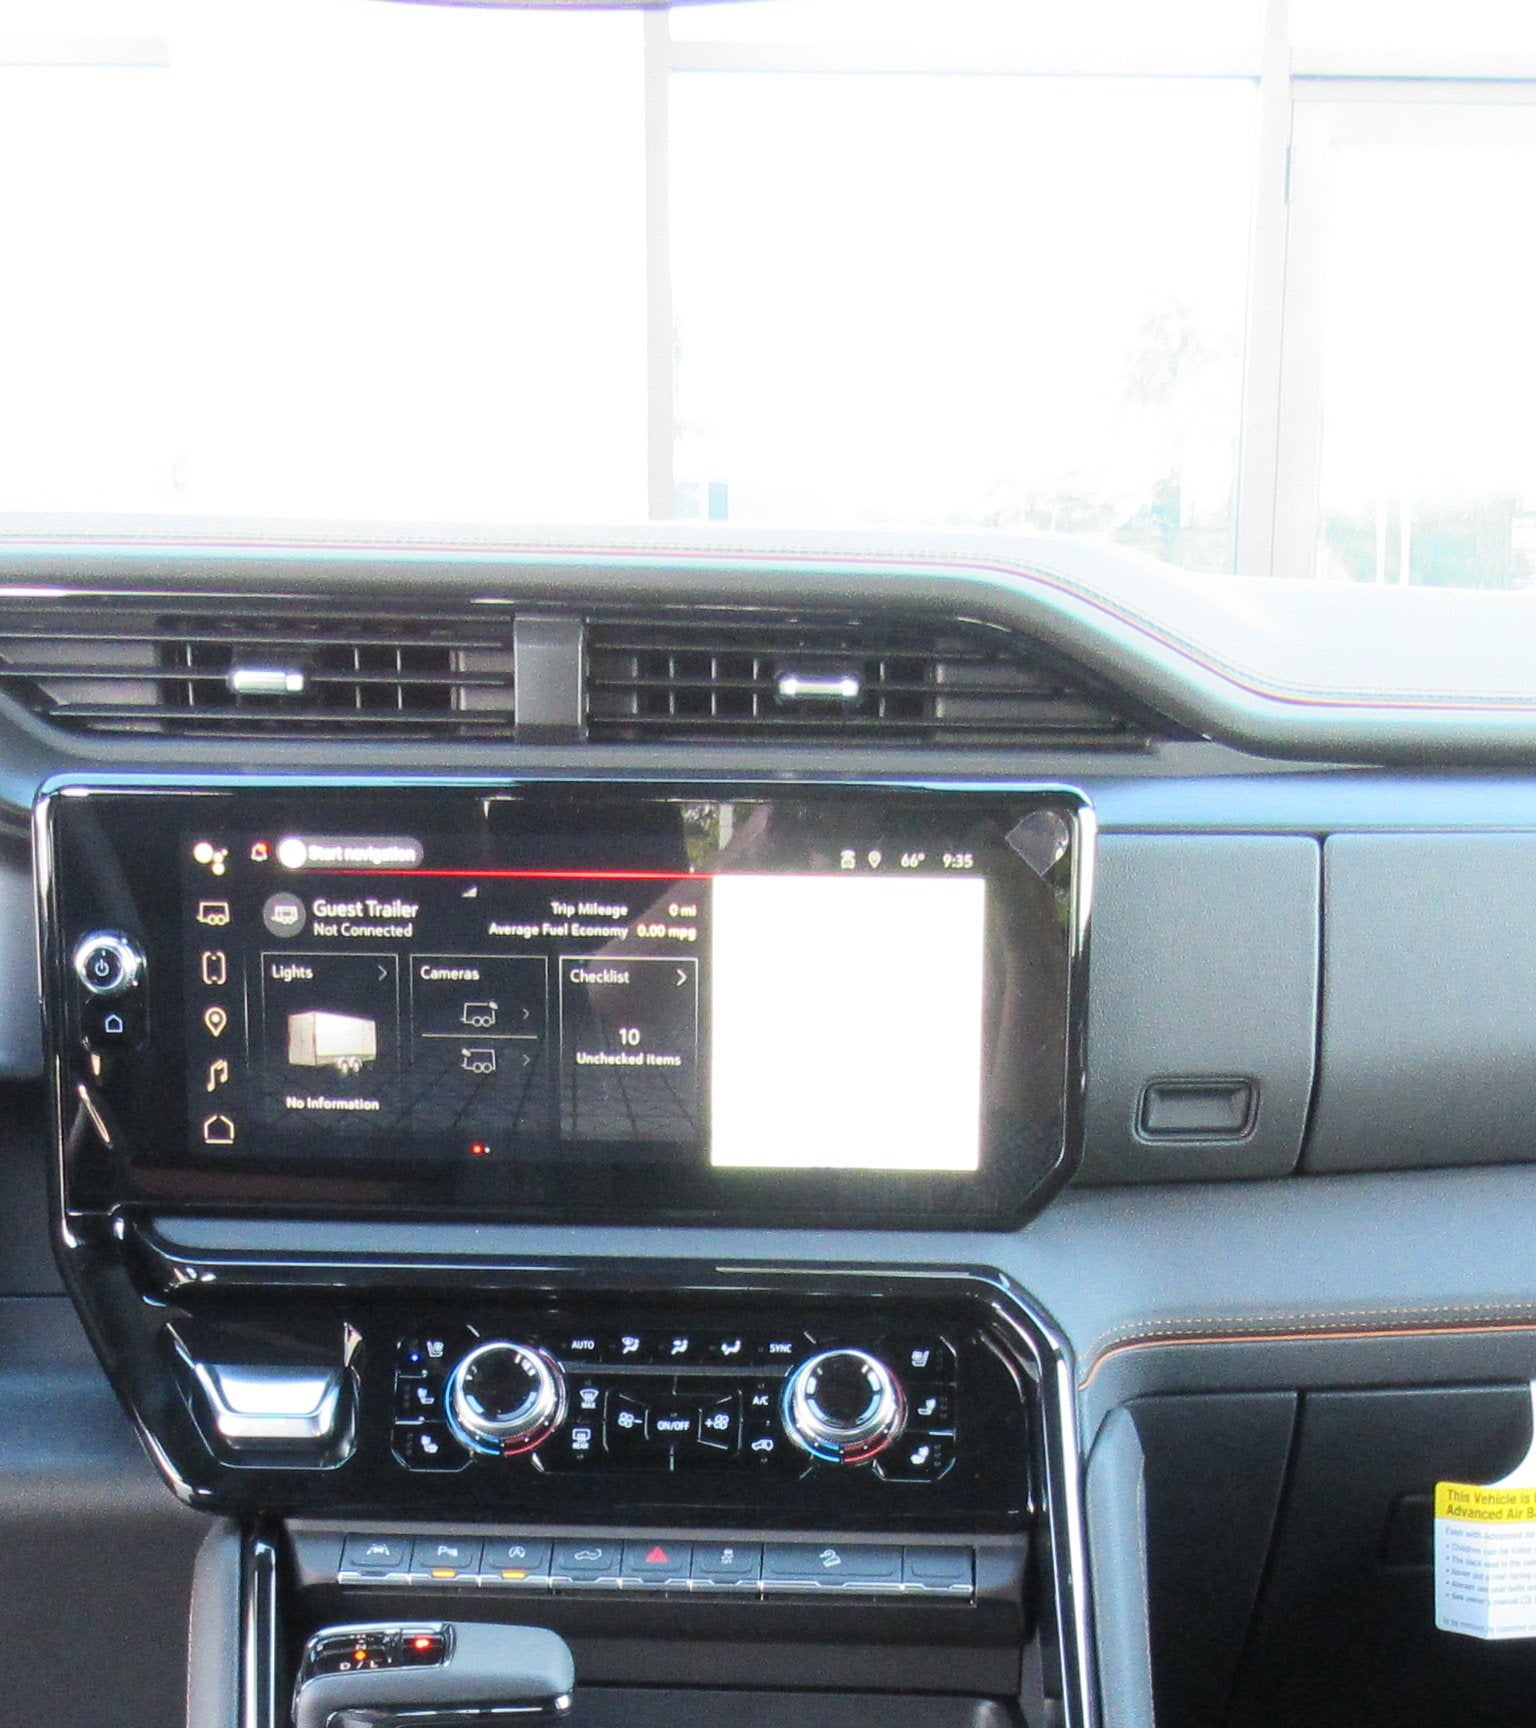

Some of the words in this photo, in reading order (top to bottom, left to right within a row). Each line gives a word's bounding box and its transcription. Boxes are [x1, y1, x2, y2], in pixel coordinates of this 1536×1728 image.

[308, 844, 342, 861] Start
[343, 845, 416, 865] navigation
[900, 852, 925, 868] 66°
[942, 854, 973, 869] 9:35
[313, 900, 363, 918] Guest
[367, 901, 419, 919] Trailer
[551, 903, 575, 918] Trip
[577, 903, 628, 919] Mileage
[668, 904, 679, 917] 0
[682, 904, 696, 917] mi
[314, 923, 337, 937] Not
[340, 923, 412, 937] Connected
[489, 923, 542, 939] Average
[544, 923, 569, 937] Fuel
[572, 924, 628, 940] Economy
[637, 926, 665, 939] 0.00
[667, 926, 697, 941] mpg
[272, 966, 313, 981] Lights
[420, 967, 479, 981] Cameras
[570, 969, 630, 985] Checklist
[619, 1028, 640, 1045] 10
[577, 1051, 642, 1066] Unchecked
[286, 1096, 305, 1109] No
[307, 1096, 380, 1112] Information
[571, 1340, 595, 1350] AUTO
[769, 1344, 792, 1354] SYNC
[581, 1401, 597, 1409] MAX
[752, 1395, 769, 1406] A/C
[657, 1420, 691, 1431] ON/OFF
[1448, 1489, 1470, 1503] This
[1474, 1491, 1516, 1505] Vehicle
[1521, 1492, 1530, 1504] is
[1447, 1504, 1503, 1519] Advanced
[1506, 1507, 1522, 1519] Air
[339, 1662, 351, 1671] D
[370, 1660, 378, 1668] L
